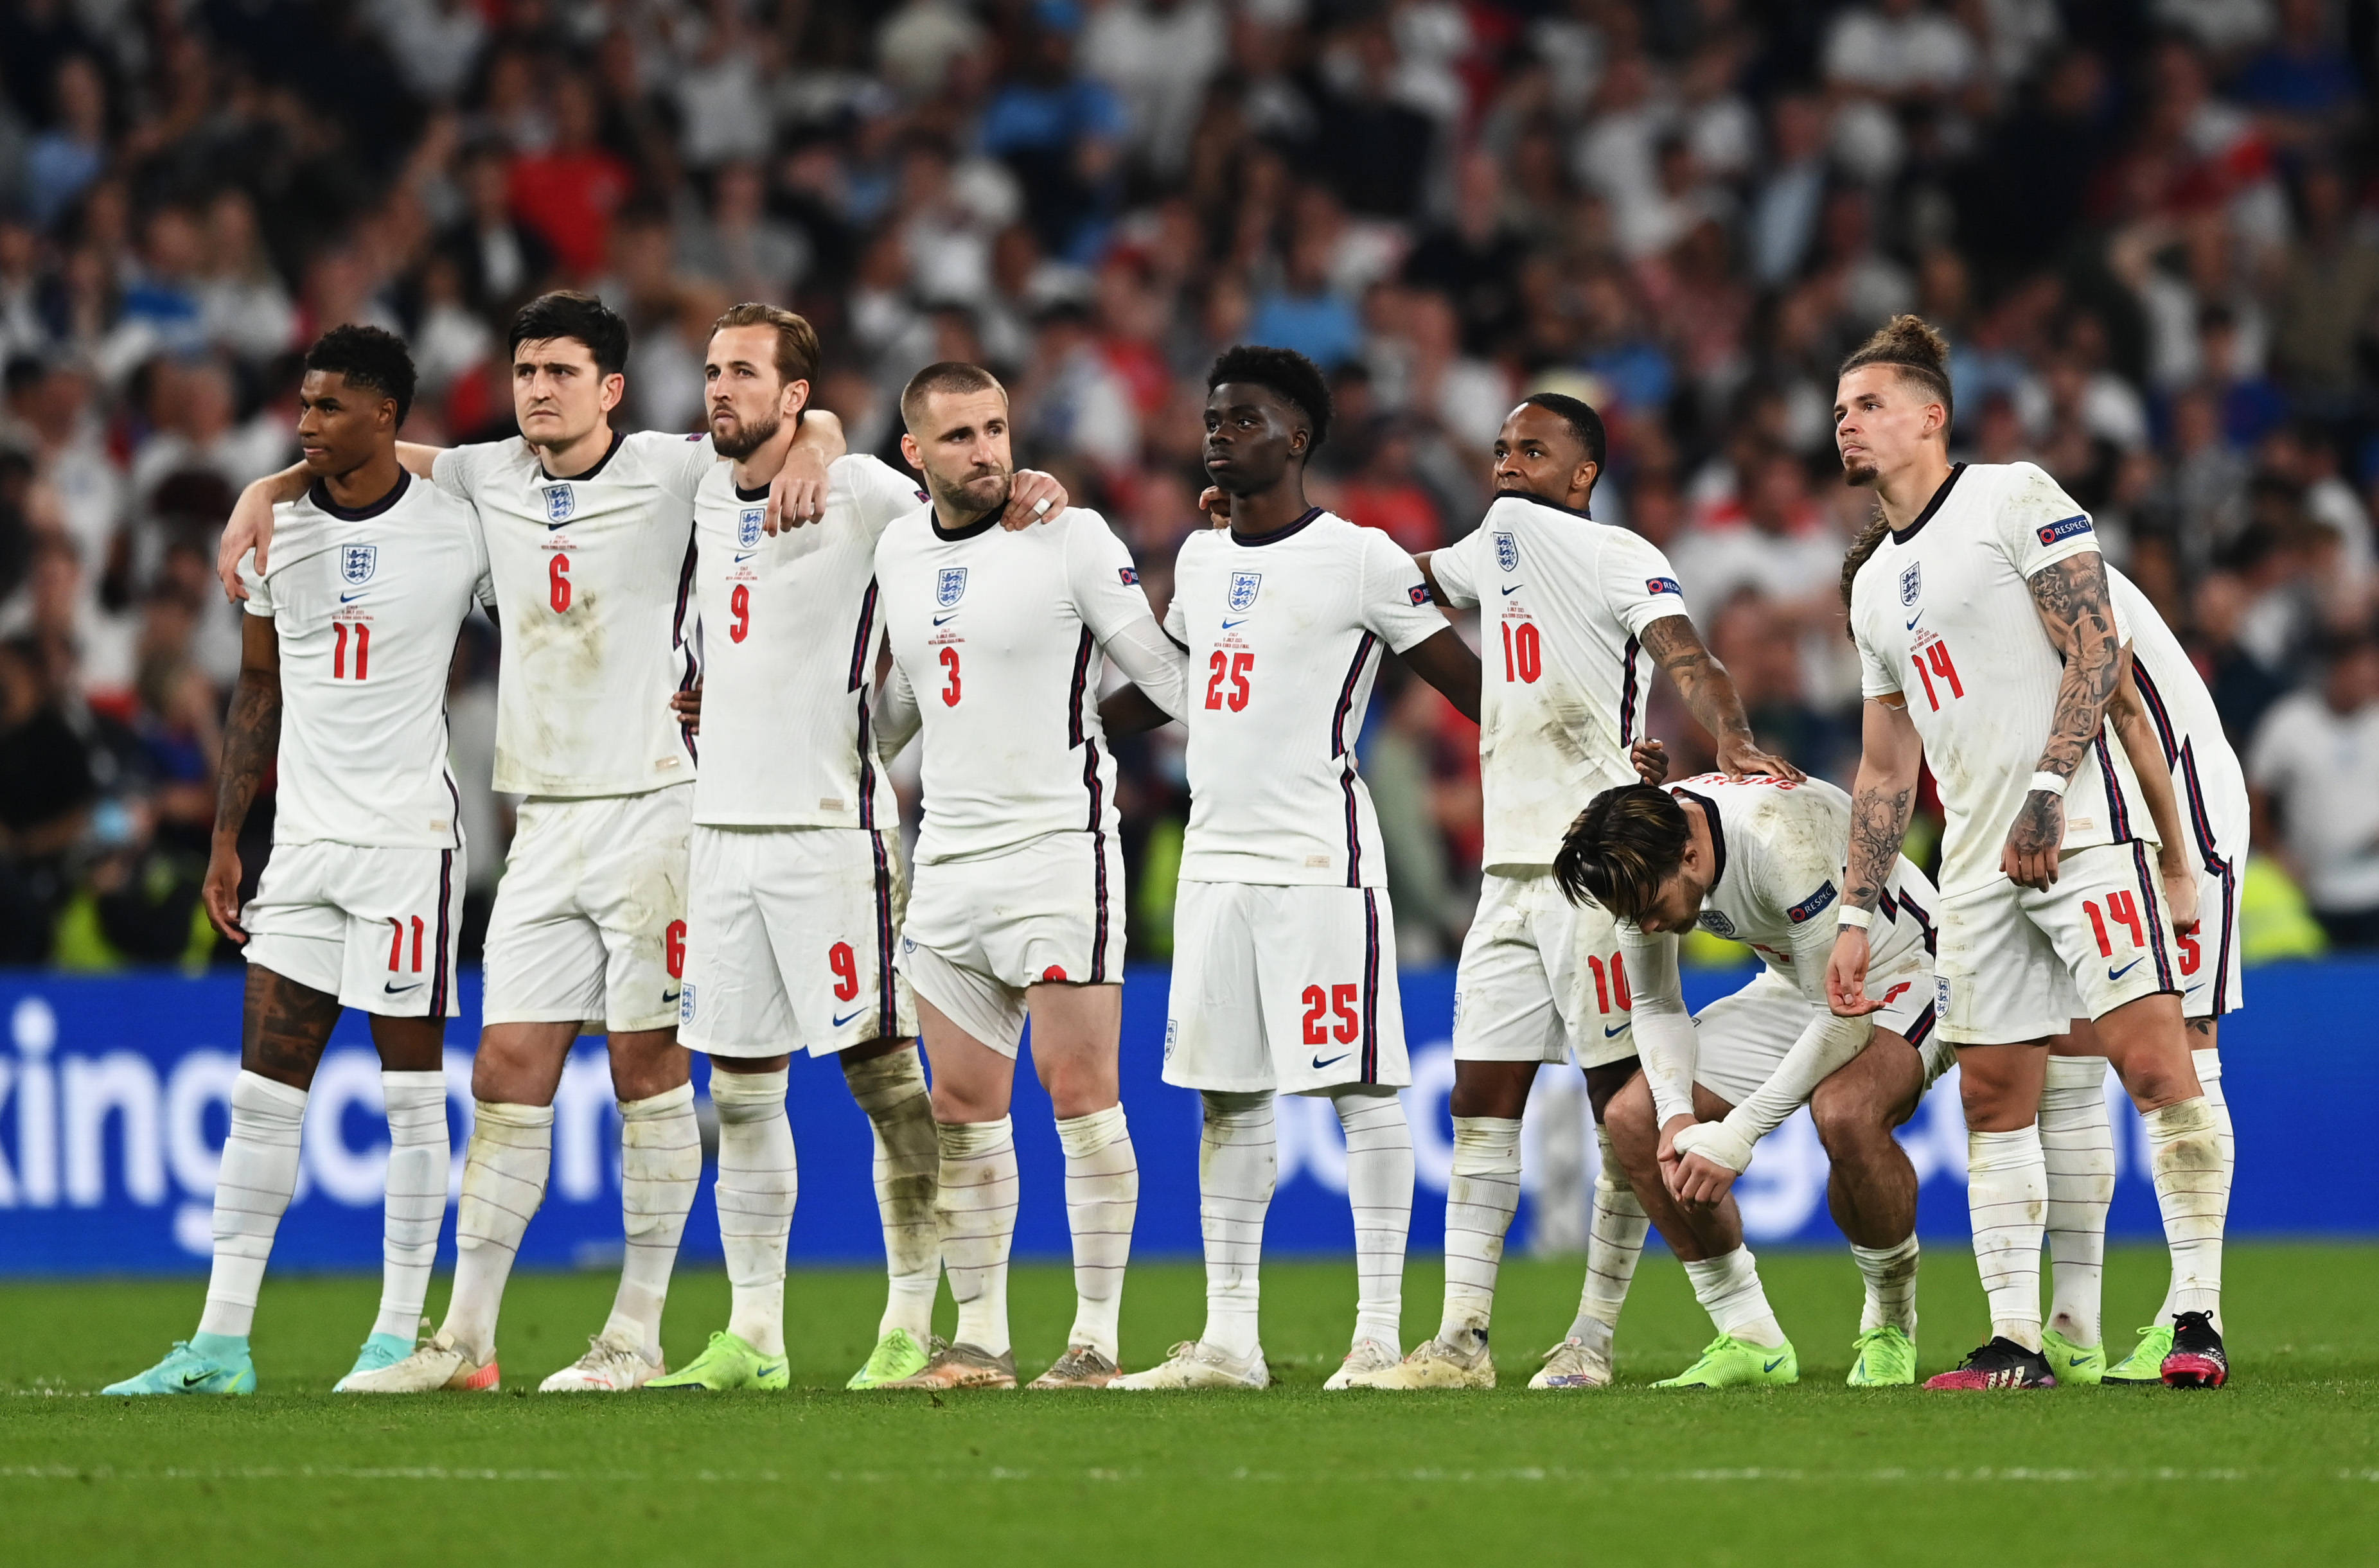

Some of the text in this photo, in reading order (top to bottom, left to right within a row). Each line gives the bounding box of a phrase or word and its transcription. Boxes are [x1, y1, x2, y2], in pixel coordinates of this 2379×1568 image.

[2055, 520, 2089, 536] RESPECT
[549, 553, 570, 613] 6
[730, 584, 750, 644] 9
[333, 622, 370, 680] 11
[940, 646, 961, 707] 3
[1205, 650, 1255, 712] 25
[1501, 621, 1541, 683] 10
[1912, 640, 1965, 712] 14
[1804, 884, 1834, 913] RESPECT
[2083, 889, 2145, 958] 14
[388, 915, 424, 973] 11
[666, 919, 687, 980] 6
[829, 941, 859, 1001] 9
[2177, 919, 2200, 976] 5
[1588, 951, 1632, 1014] 10
[1302, 983, 1359, 1045] 25
